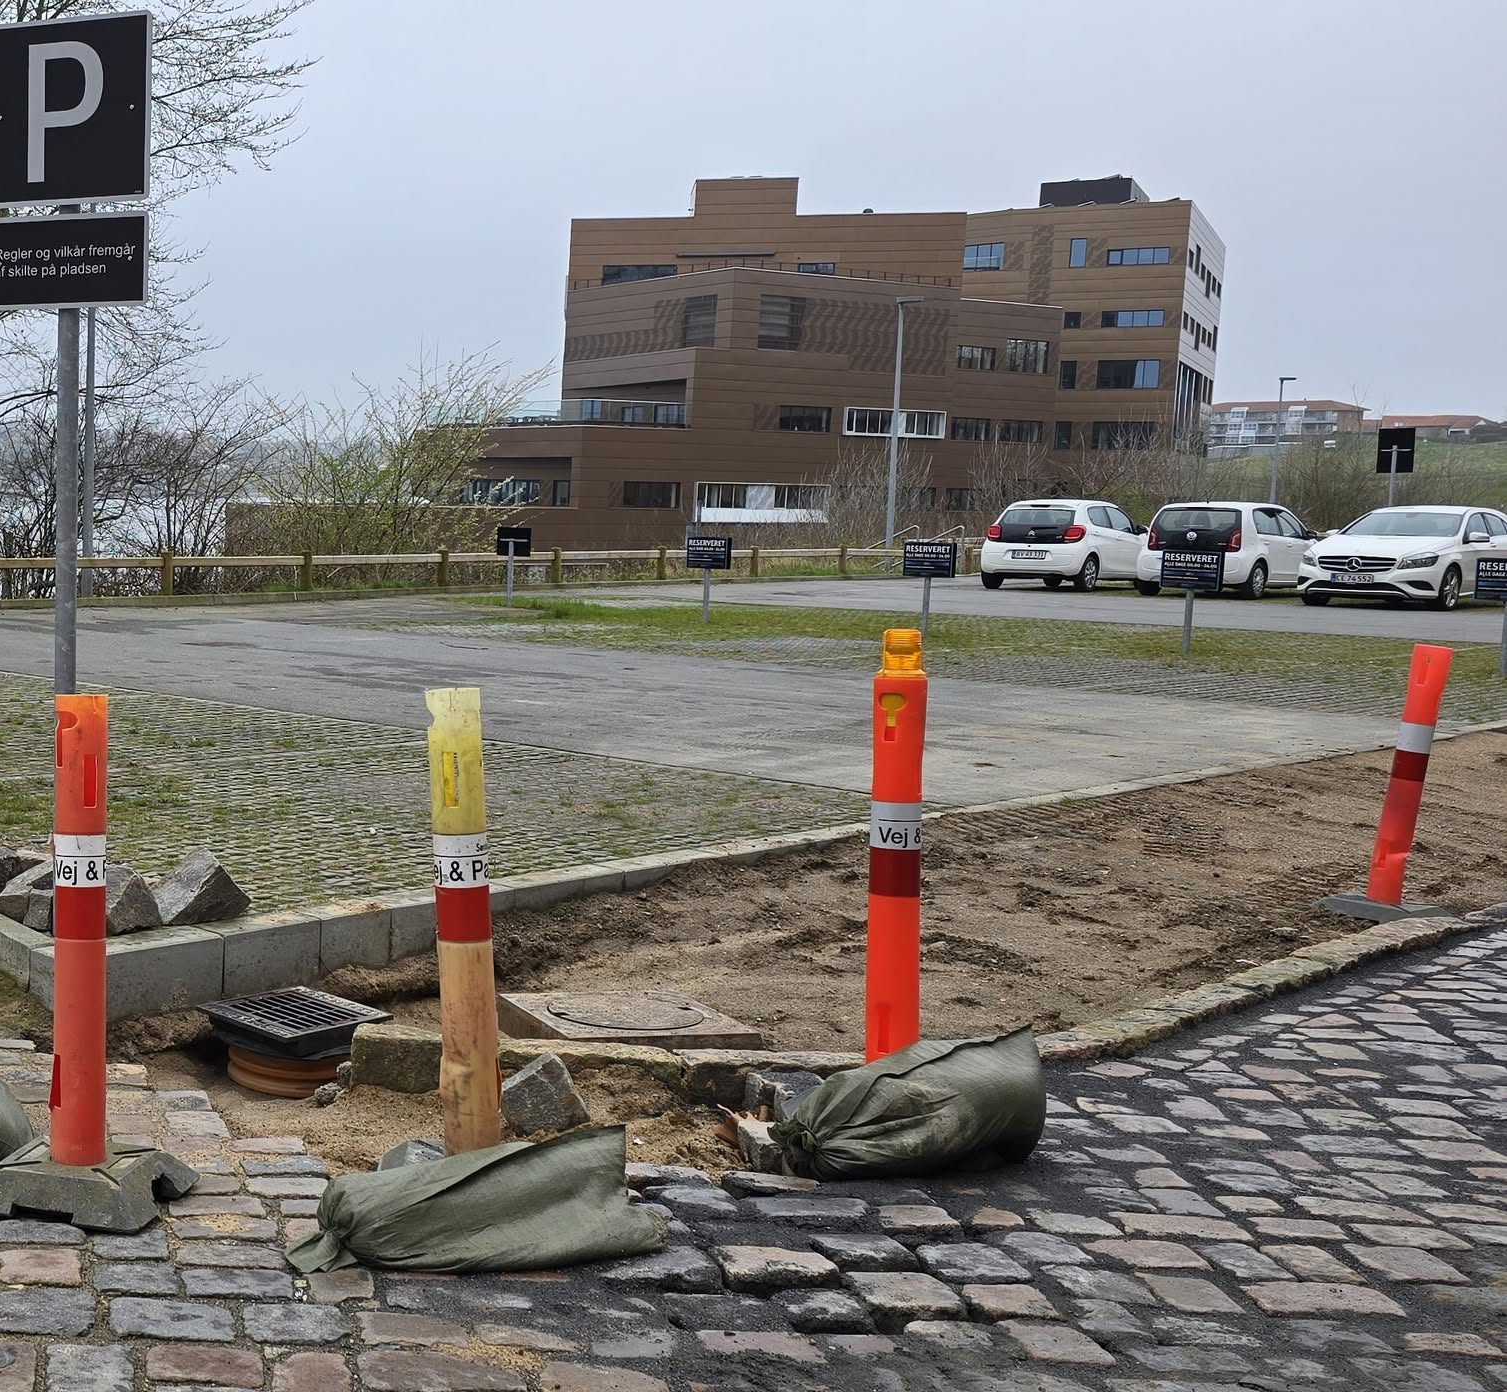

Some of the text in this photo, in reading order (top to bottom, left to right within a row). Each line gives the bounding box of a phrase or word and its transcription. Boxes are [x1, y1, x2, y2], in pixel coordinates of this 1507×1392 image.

[27, 41, 104, 183] P
[35, 249, 50, 261] og
[54, 244, 85, 258] vilkår
[89, 243, 136, 258] fremgår
[8, 265, 38, 277] skilte
[41, 263, 56, 278] på
[60, 262, 106, 278] pladsen
[688, 539, 725, 547] RESERVERET
[905, 545, 950, 553] RESERVERET
[1165, 552, 1218, 563] RESERVERET
[878, 827, 908, 848] Vej
[56, 860, 78, 885] Vej
[86, 861, 99, 880] &
[449, 861, 465, 881] &
